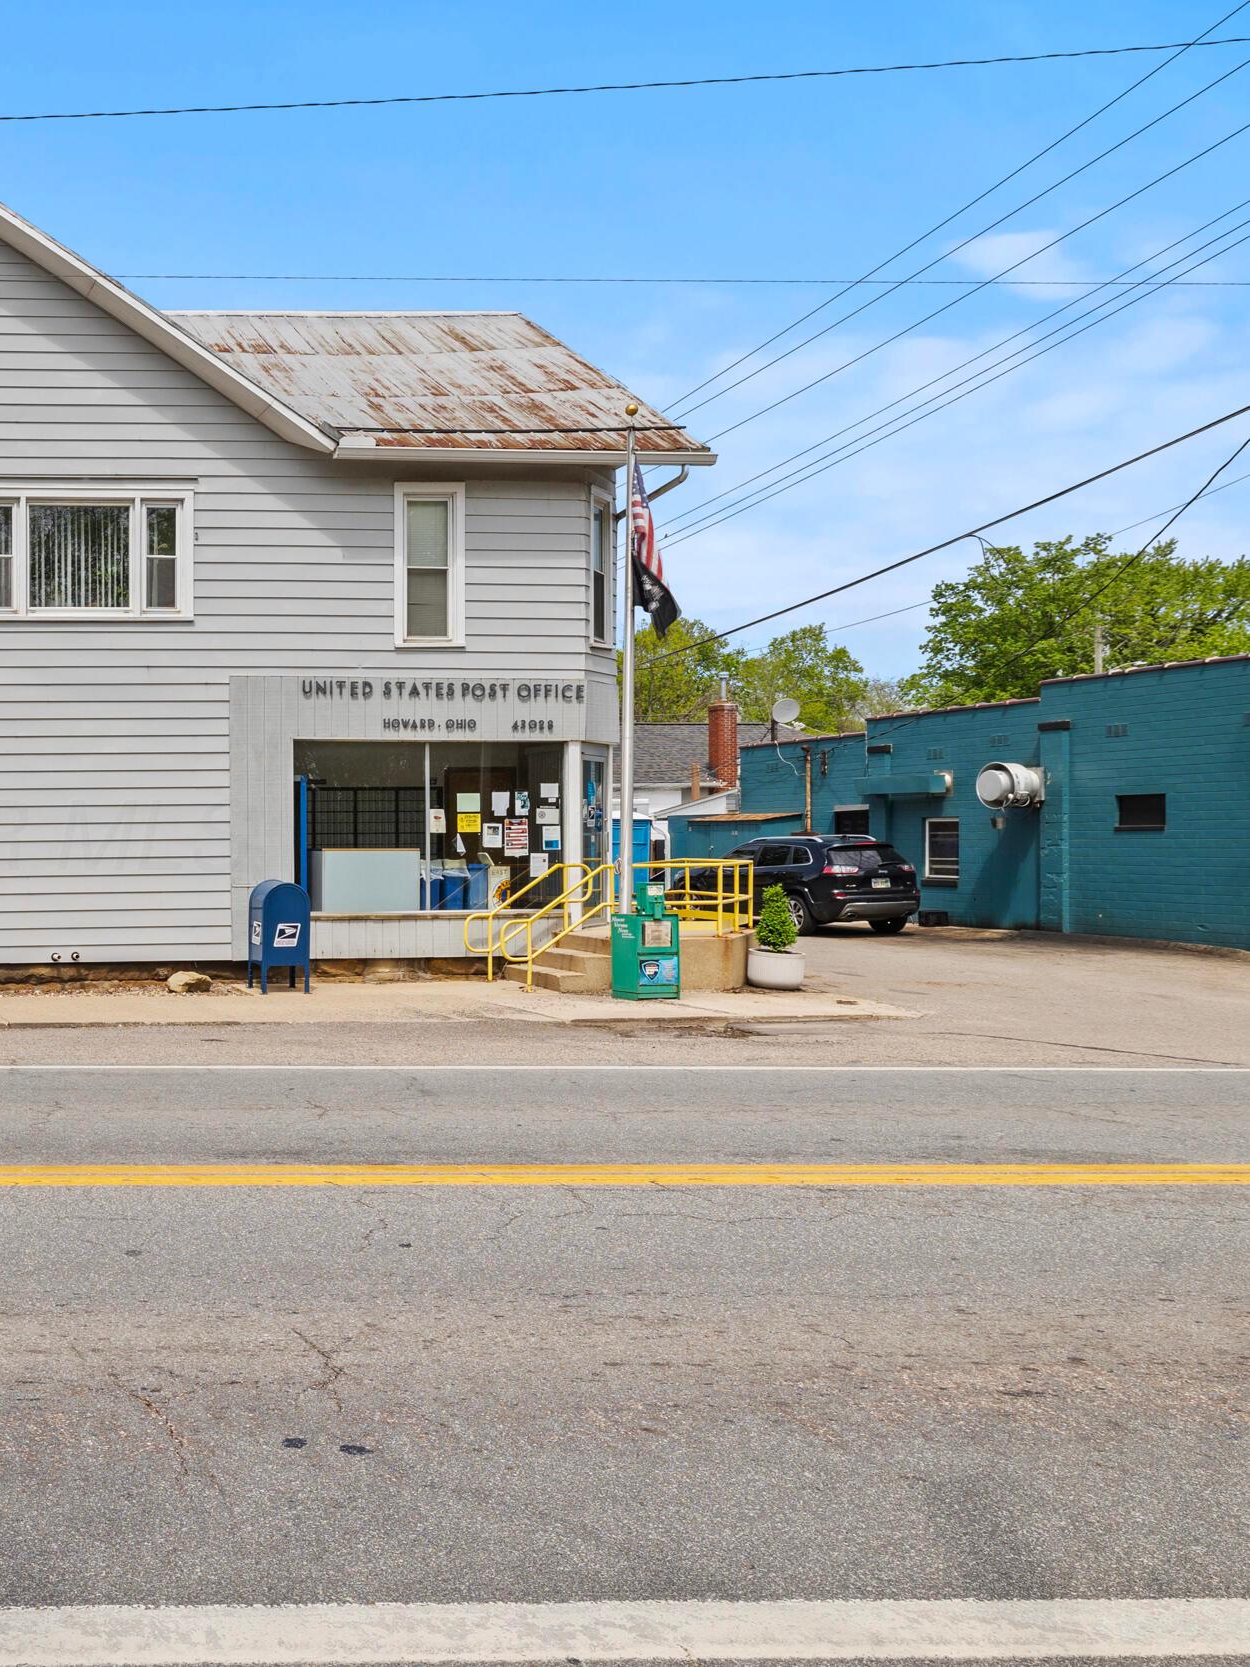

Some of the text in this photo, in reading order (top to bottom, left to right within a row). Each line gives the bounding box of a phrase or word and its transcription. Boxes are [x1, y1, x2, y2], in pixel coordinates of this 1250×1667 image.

[302, 680, 585, 700] UNITED STATES POST OFFICE
[446, 719, 477, 731] OHIO
[512, 719, 554, 732] 43028
